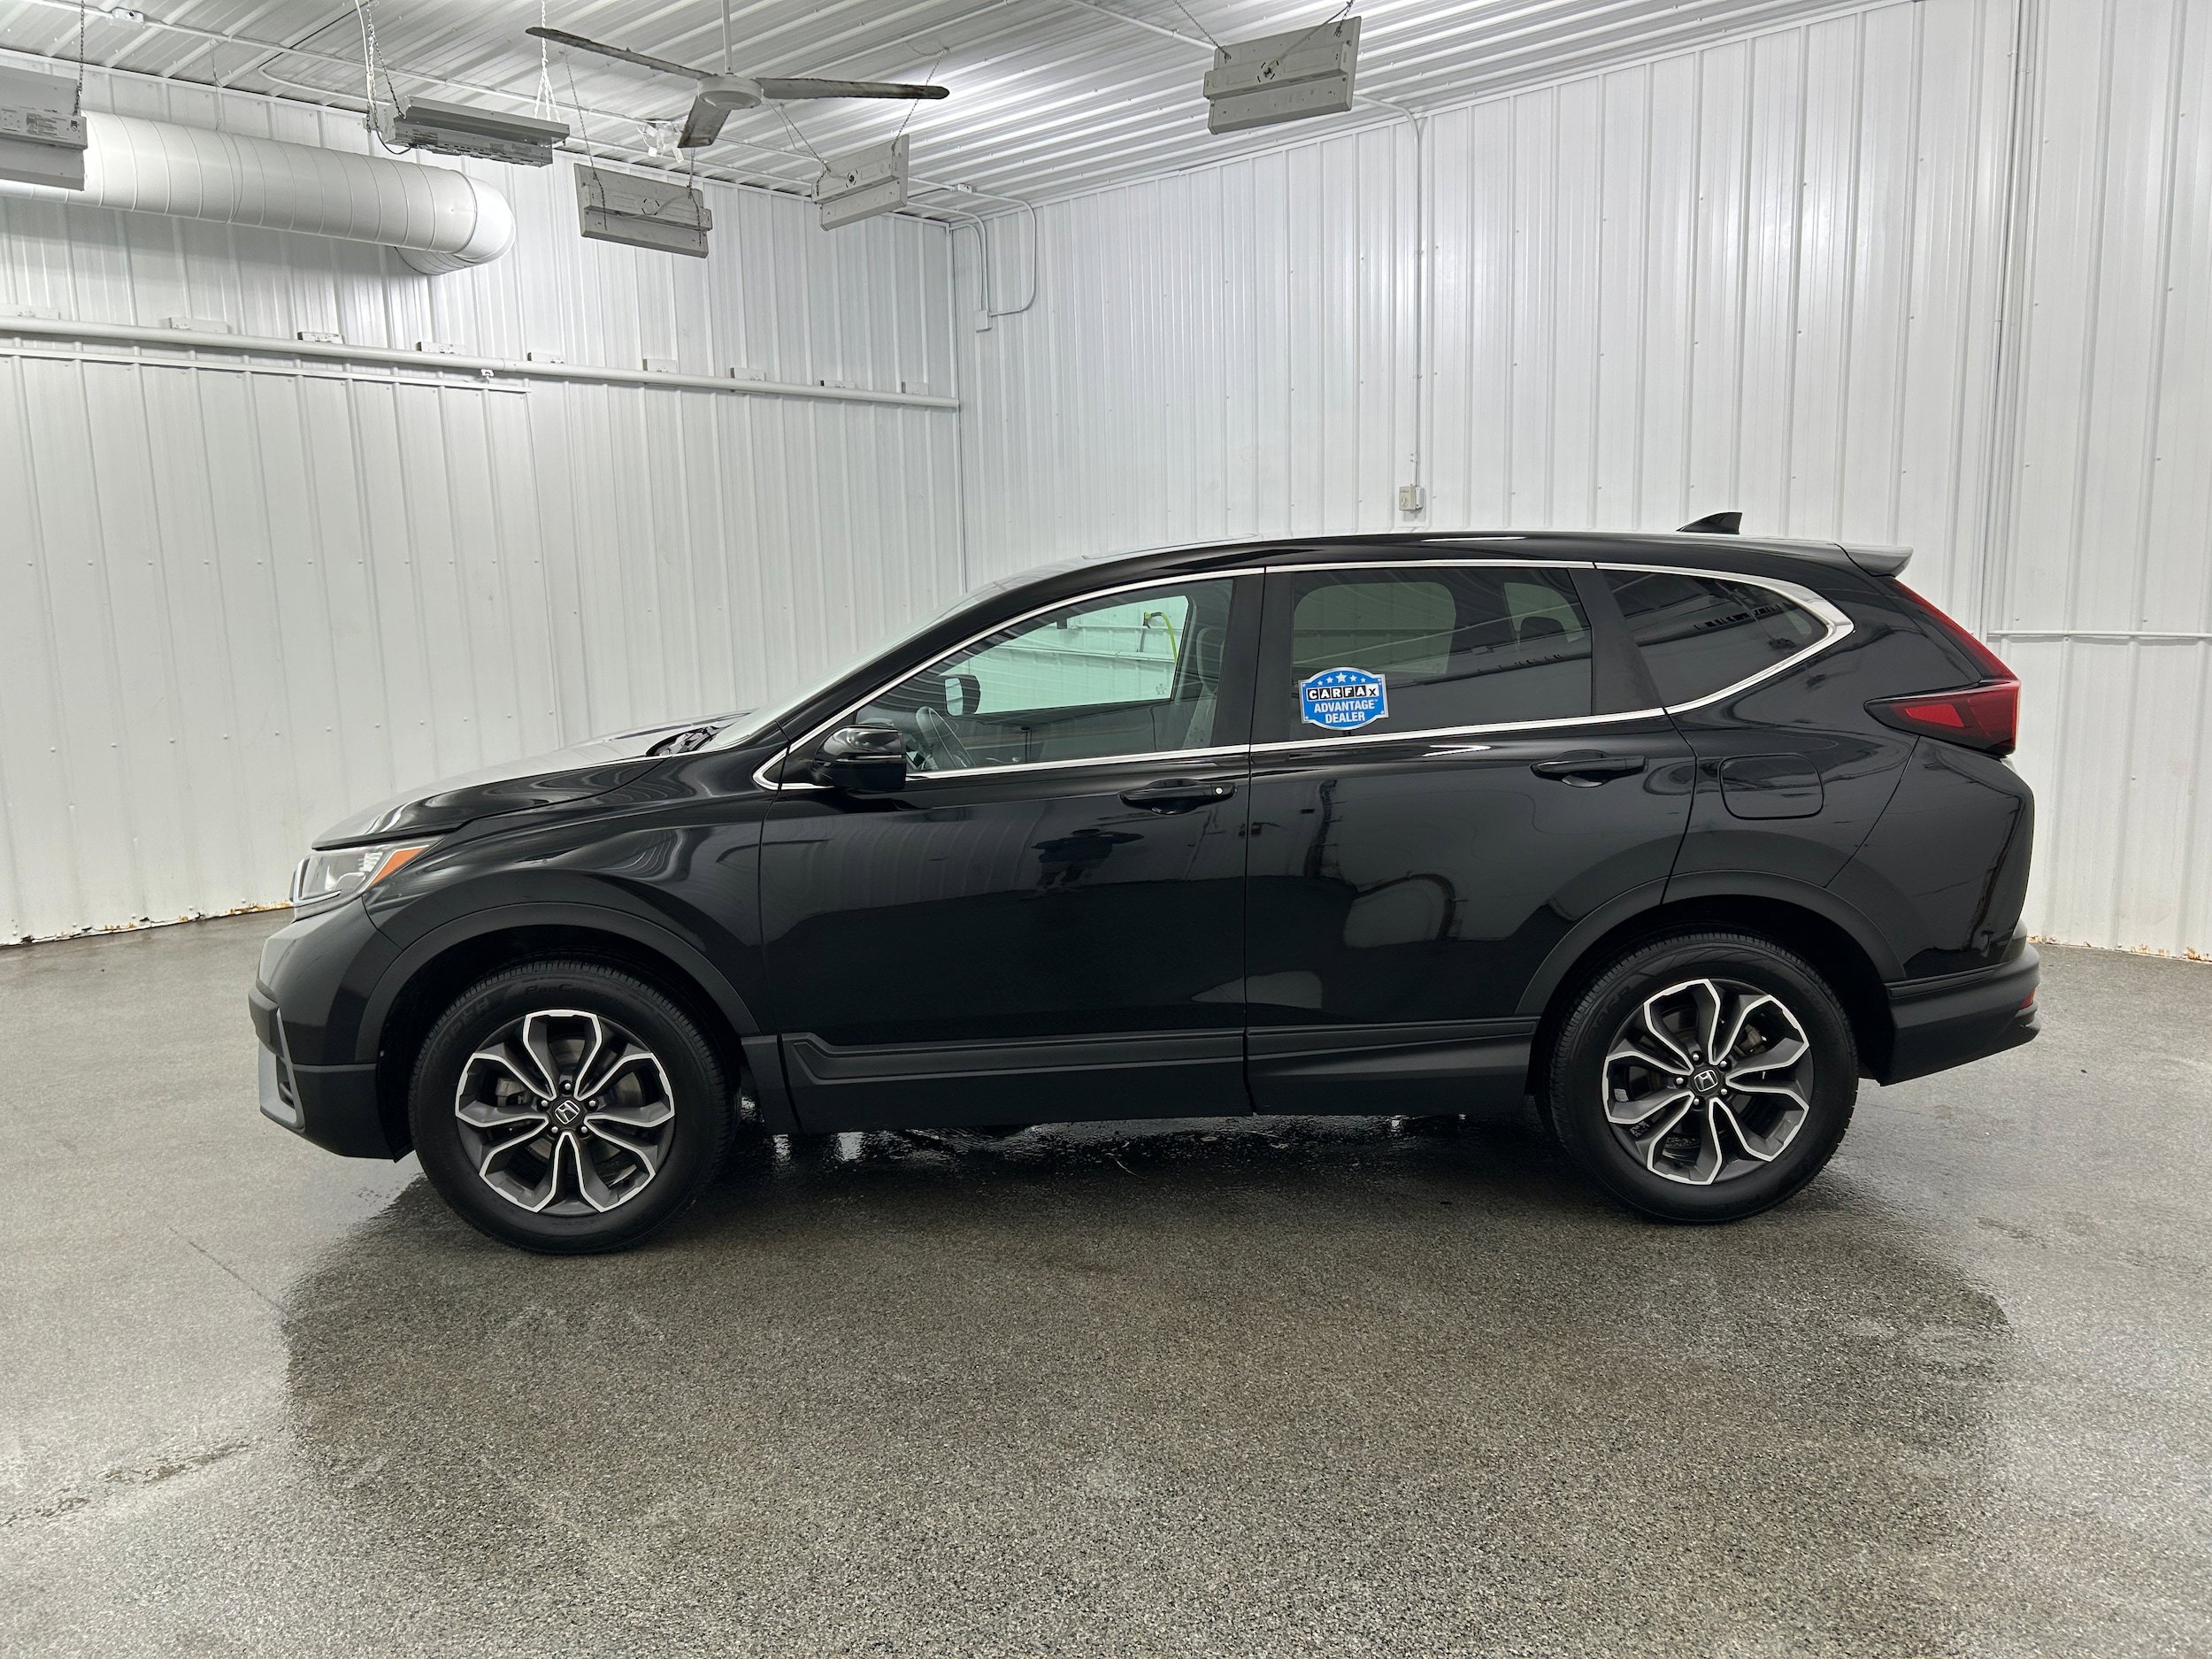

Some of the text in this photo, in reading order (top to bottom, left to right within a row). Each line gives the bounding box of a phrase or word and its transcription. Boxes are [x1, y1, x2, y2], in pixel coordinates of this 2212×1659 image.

[1309, 686, 1378, 700] CARFAX
[1314, 700, 1375, 713] ADVANTAGE
[1325, 712, 1365, 724] DEALER
